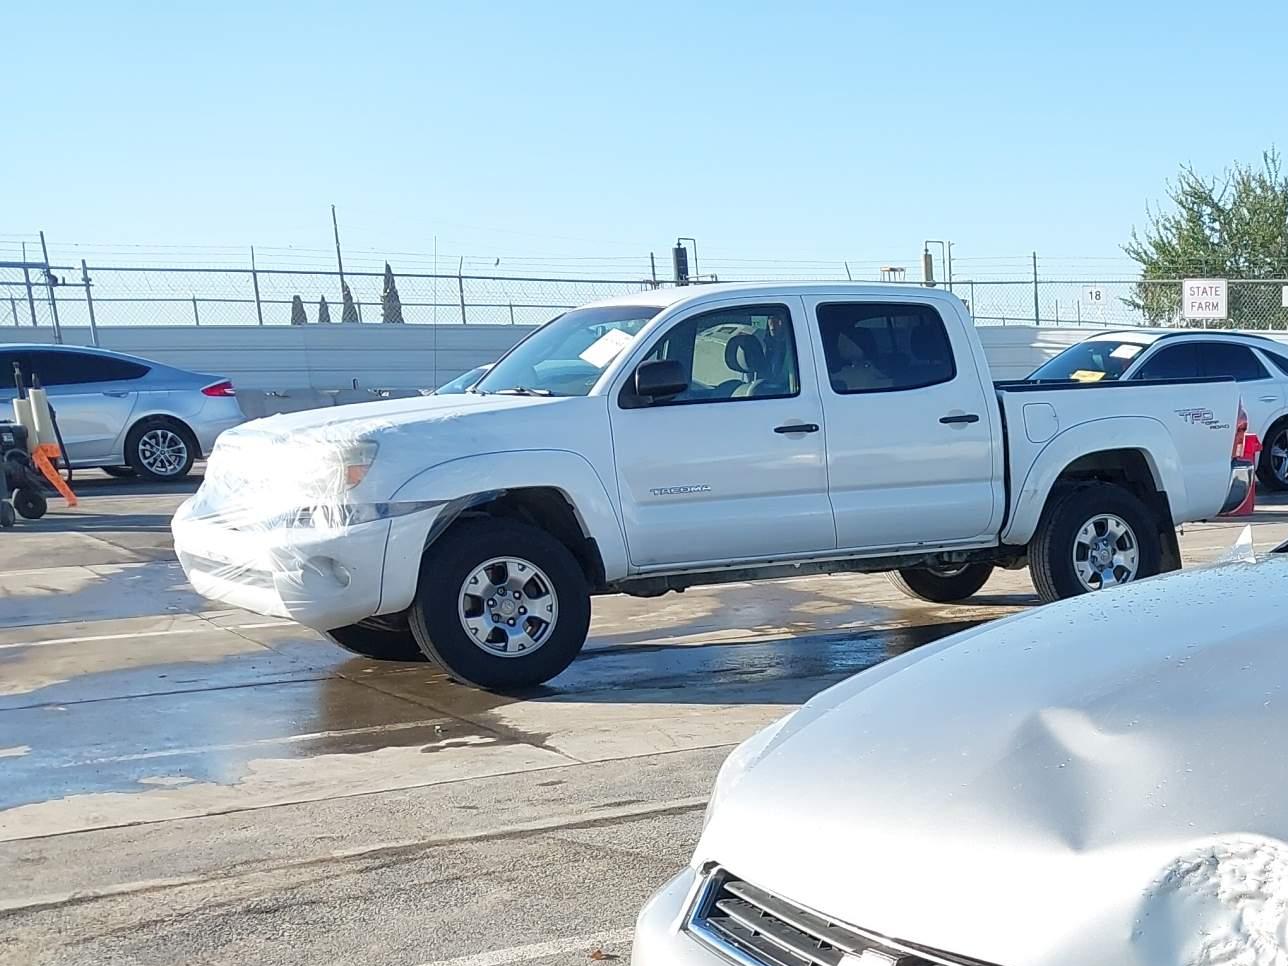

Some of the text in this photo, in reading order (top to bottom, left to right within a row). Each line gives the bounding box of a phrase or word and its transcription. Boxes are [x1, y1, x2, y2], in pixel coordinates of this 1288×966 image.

[1089, 290, 1101, 301] 18
[1189, 286, 1221, 297] STATE
[1190, 302, 1220, 313] FARM
[1178, 411, 1214, 424] TRD
[649, 484, 712, 496] TACOMA
